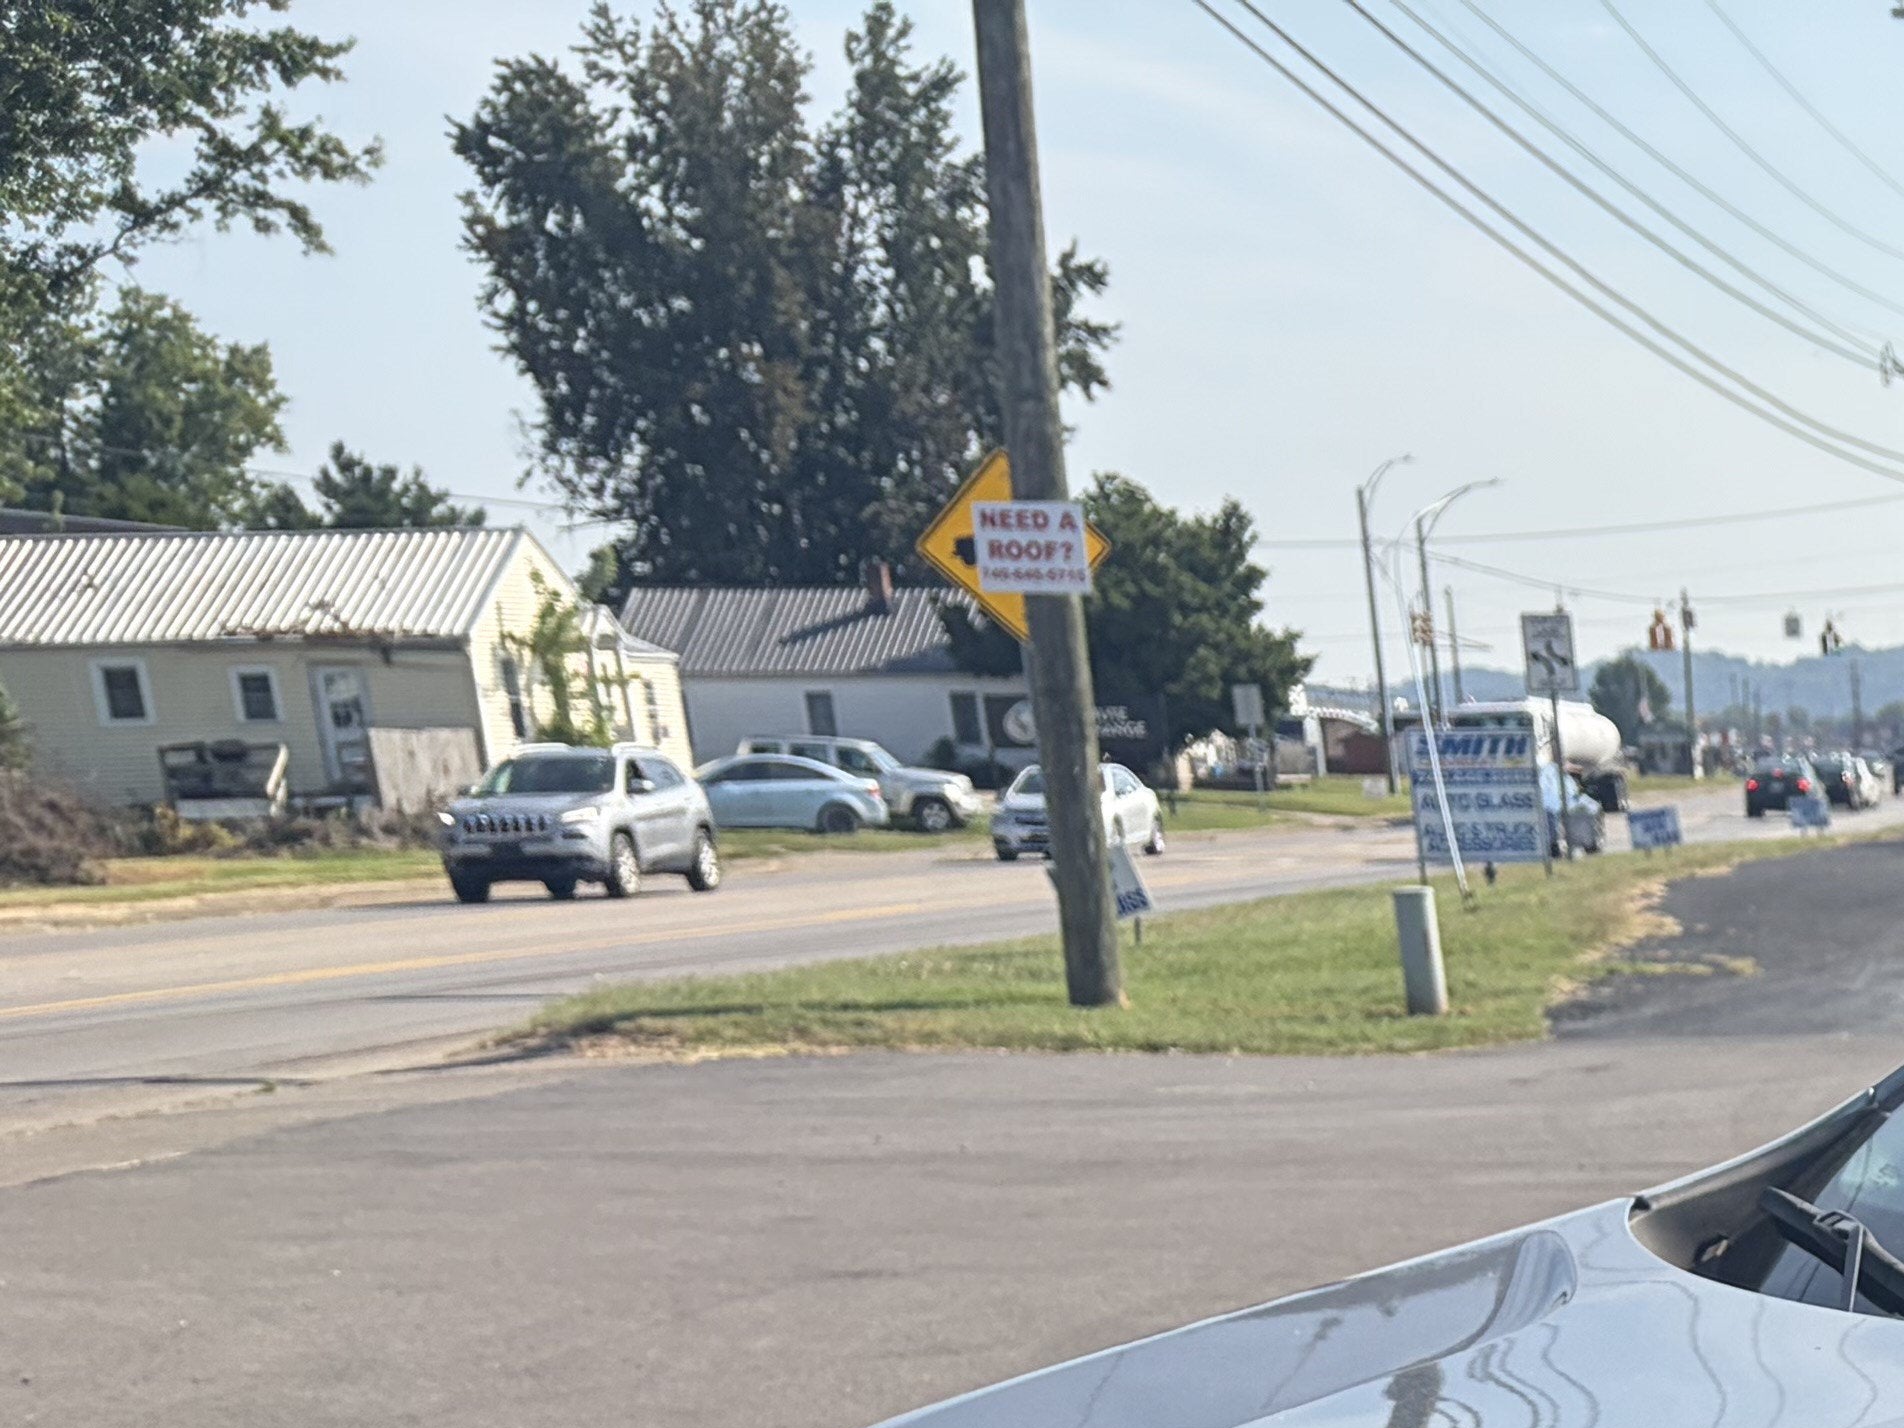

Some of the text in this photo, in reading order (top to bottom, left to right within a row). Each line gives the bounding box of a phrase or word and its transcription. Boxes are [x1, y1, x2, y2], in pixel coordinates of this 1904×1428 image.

[980, 508, 1078, 532] NEED A
[987, 539, 1074, 561] ROOF?
